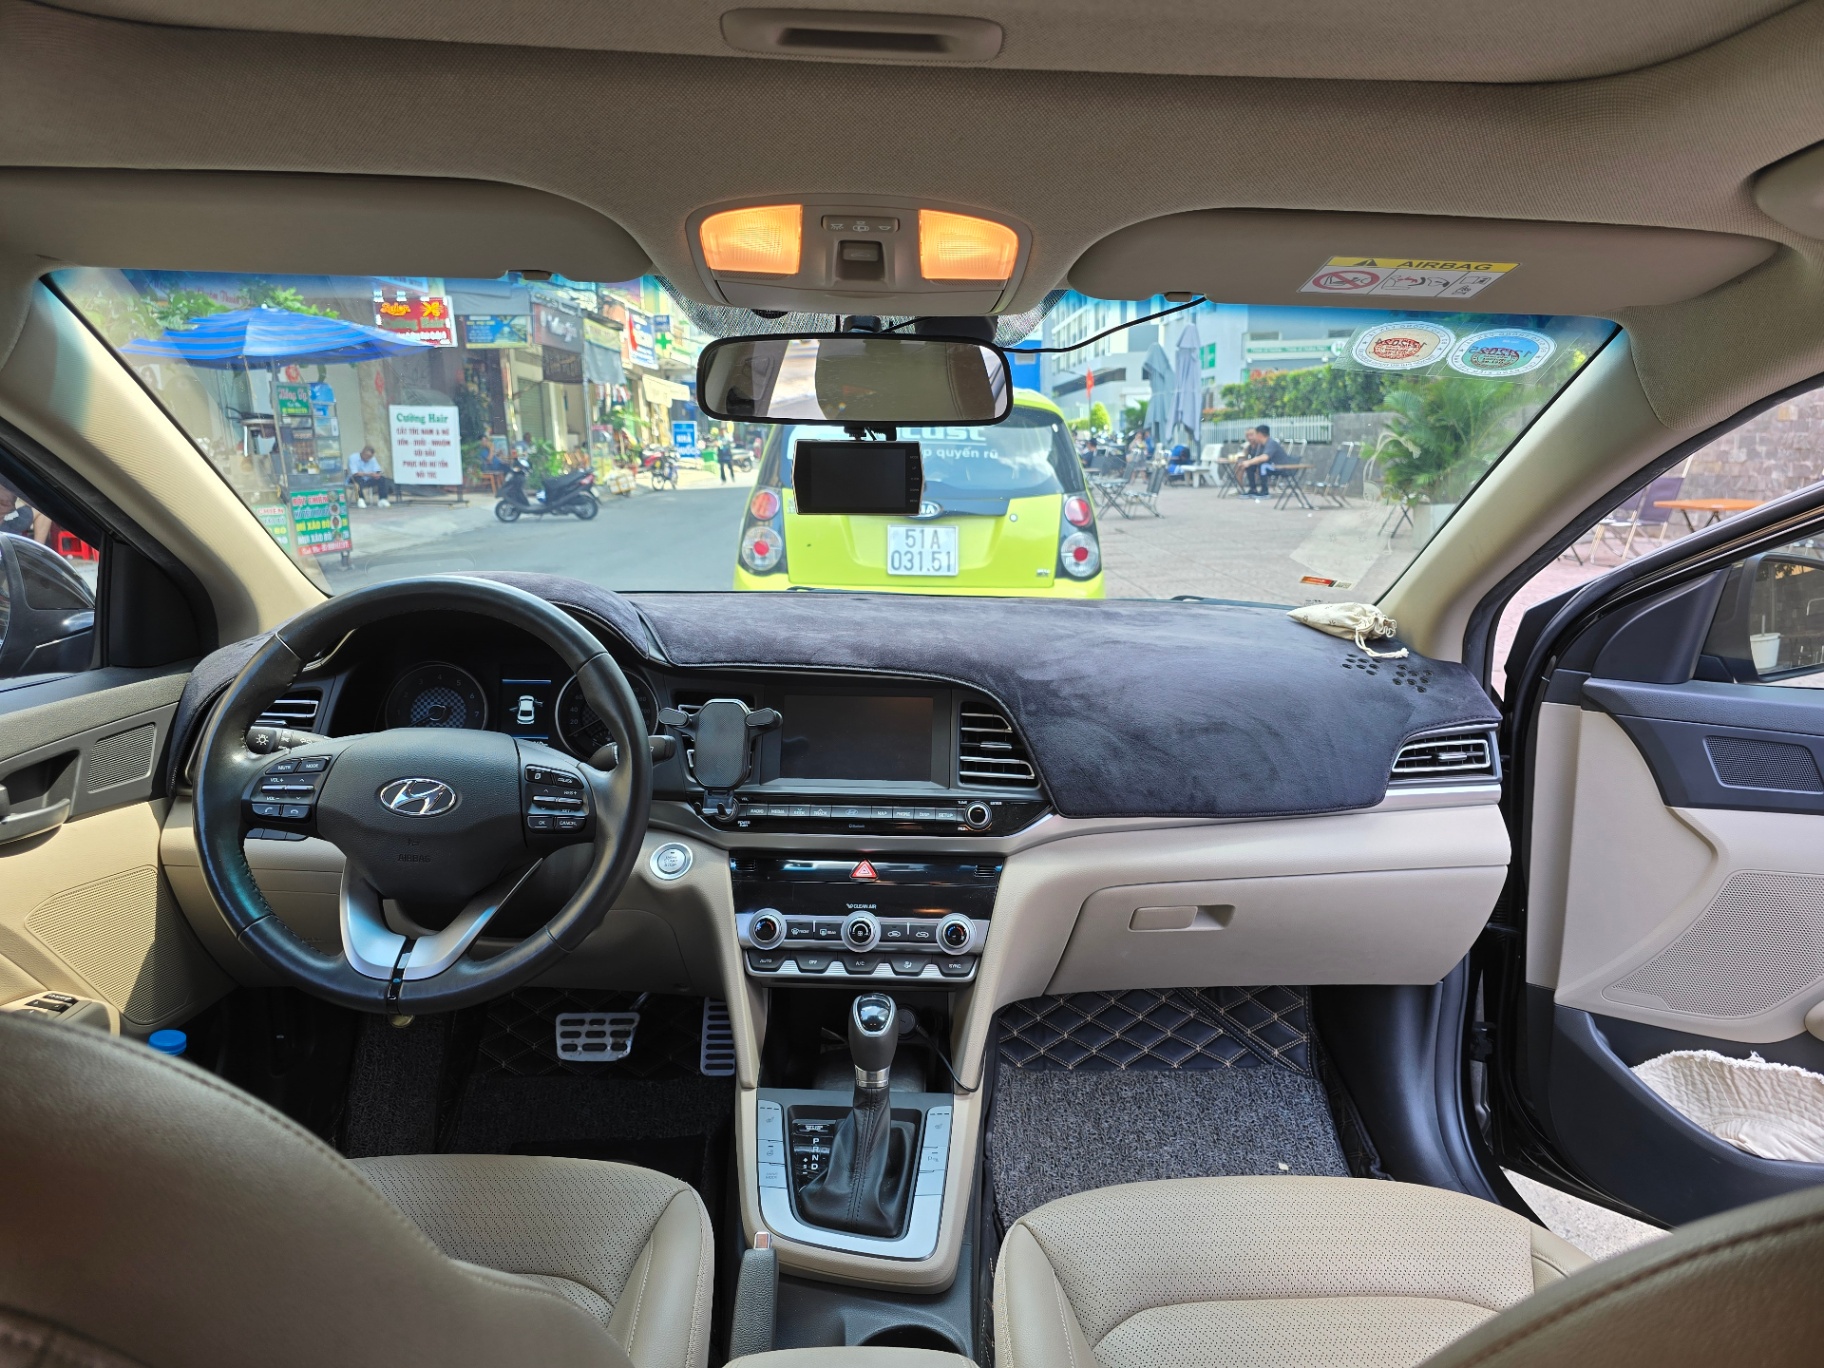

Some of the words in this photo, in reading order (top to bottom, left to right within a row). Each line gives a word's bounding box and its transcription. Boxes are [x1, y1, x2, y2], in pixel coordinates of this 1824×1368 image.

[1397, 261, 1493, 271] AIRBAG
[396, 413, 426, 425] Cường
[428, 413, 449, 424] Hair
[936, 446, 980, 460] quyến
[905, 528, 941, 550] 51A
[890, 549, 951, 573] 031.51
[812, 1137, 820, 1145] P
